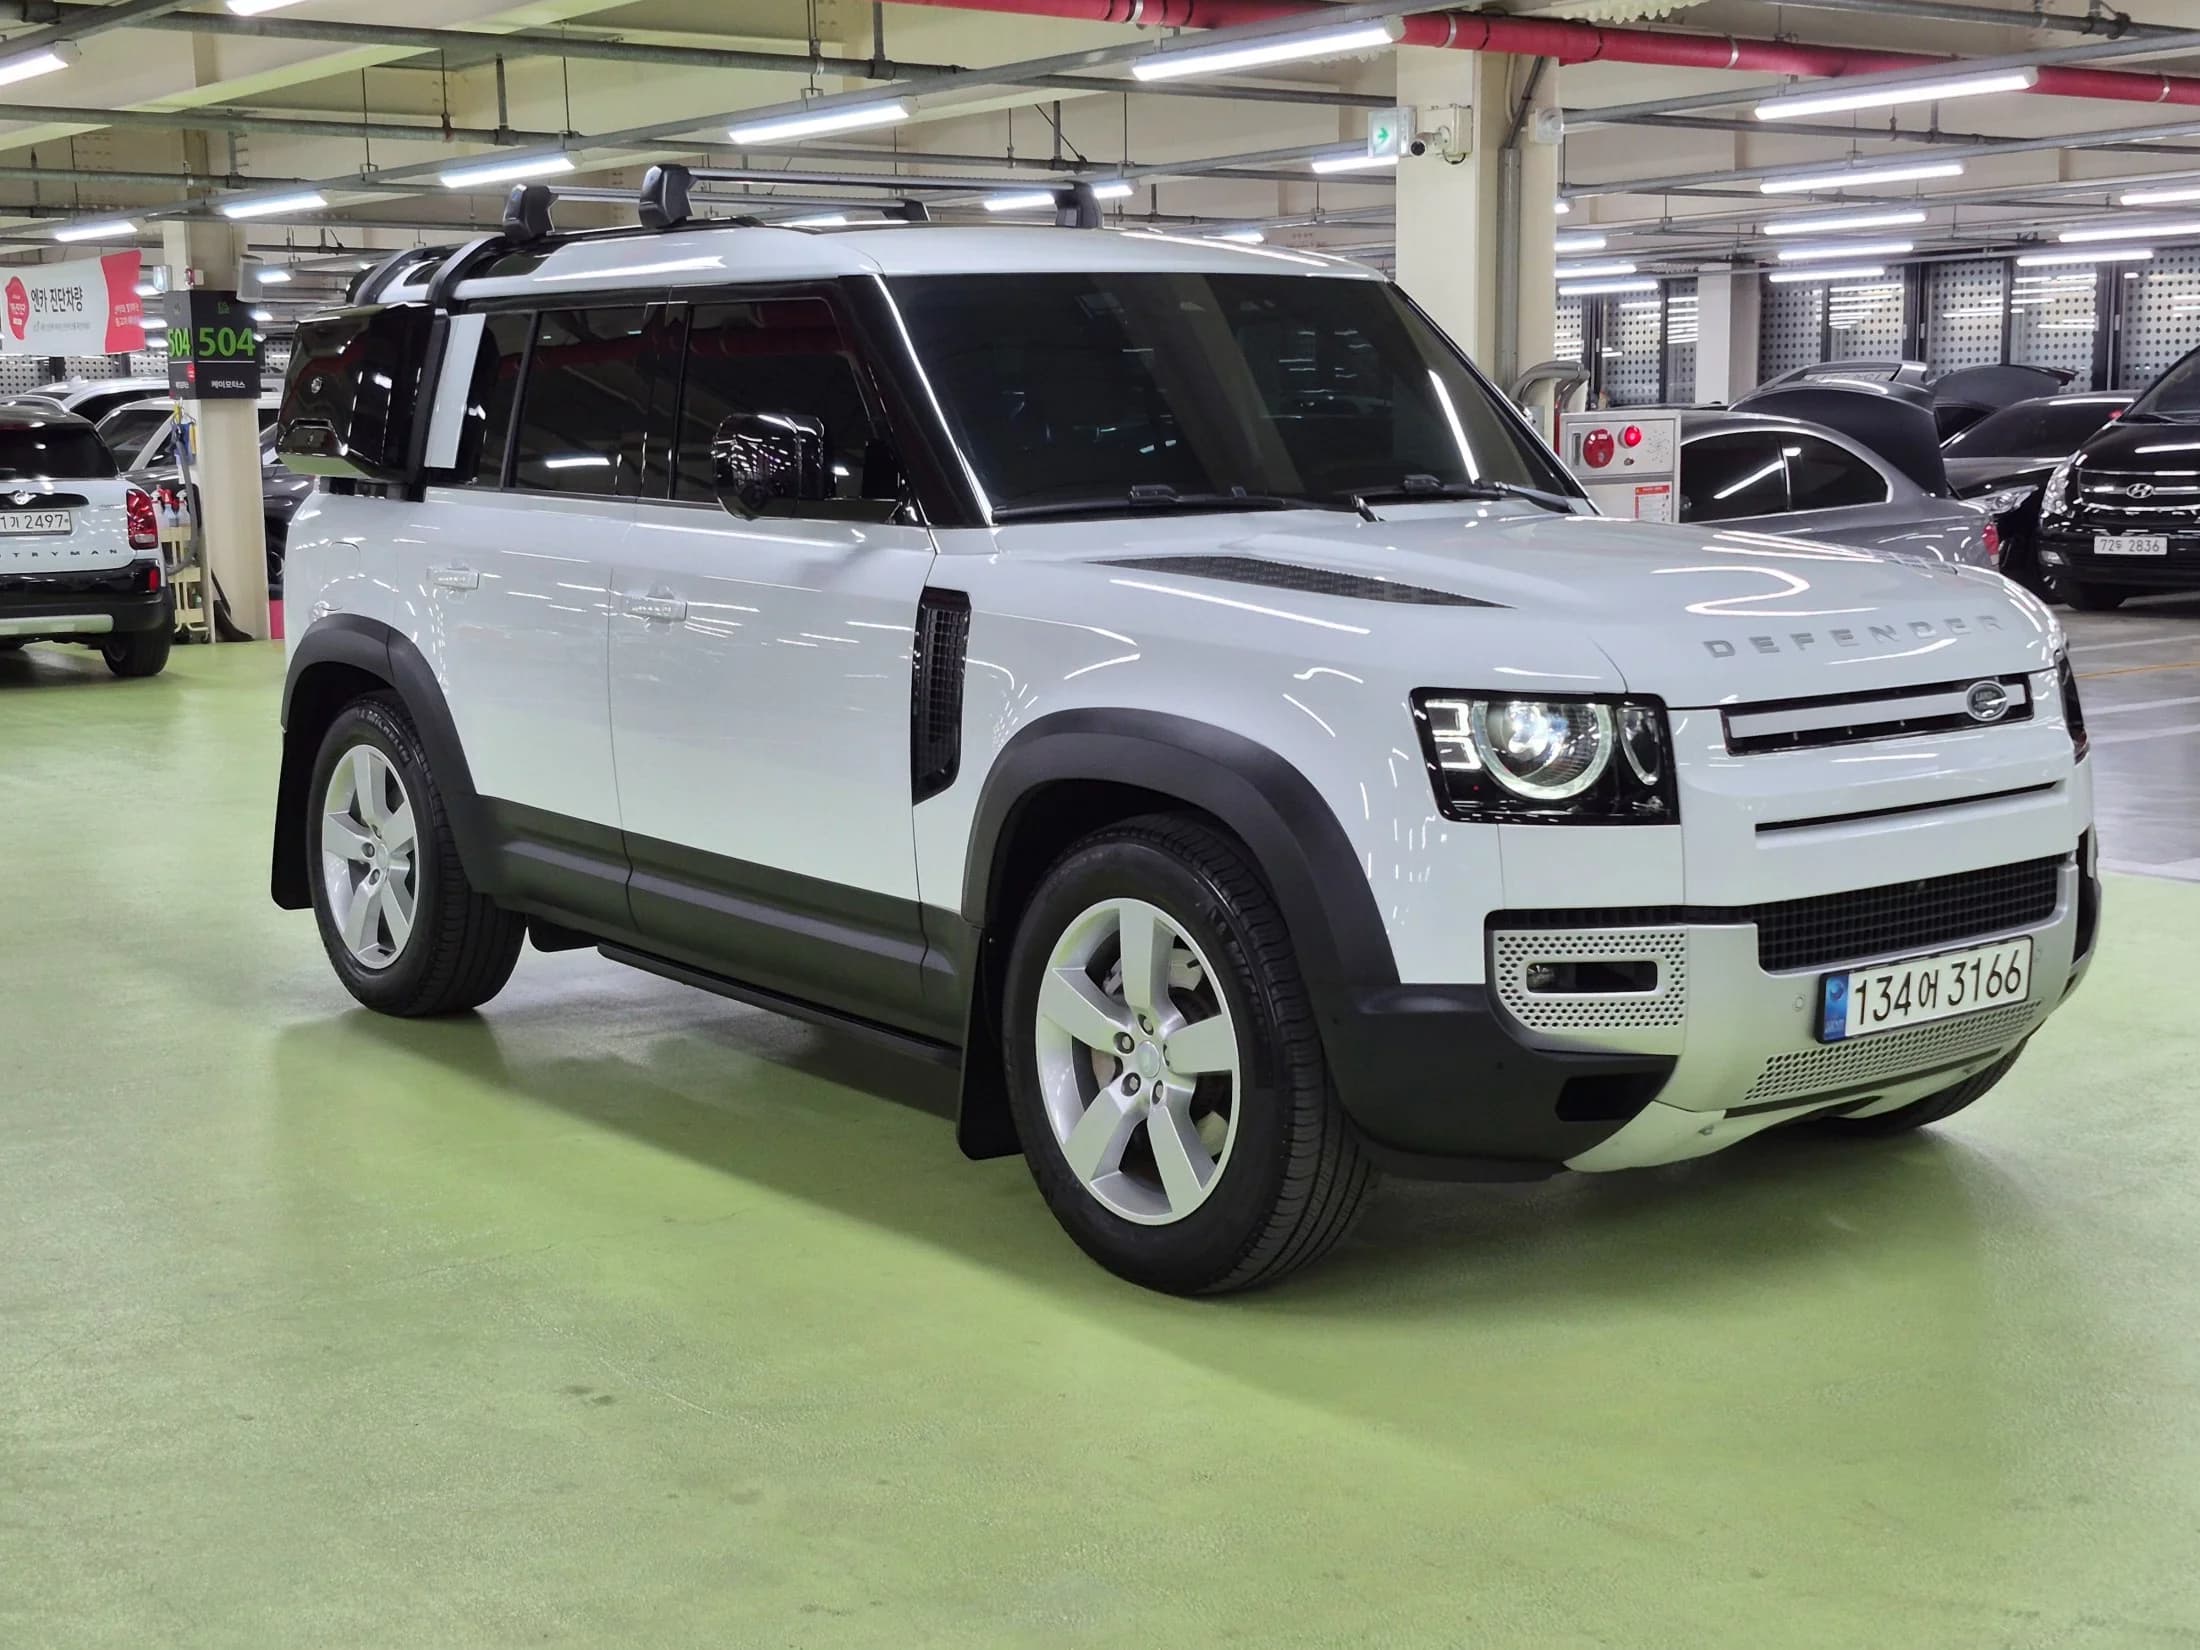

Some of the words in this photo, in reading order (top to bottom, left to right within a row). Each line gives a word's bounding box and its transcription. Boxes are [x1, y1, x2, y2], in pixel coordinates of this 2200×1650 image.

[31, 287, 47, 312] 엔카
[50, 286, 83, 312] 진단차량
[167, 327, 191, 357] 504
[199, 327, 256, 357] 504
[24, 513, 63, 529] 2497
[0, 548, 118, 558] TRYMAN
[2128, 539, 2160, 552] 2836
[1702, 615, 2004, 658] DEFENDER
[1855, 969, 1939, 1026] 134어
[1948, 949, 2021, 1006] 3166
